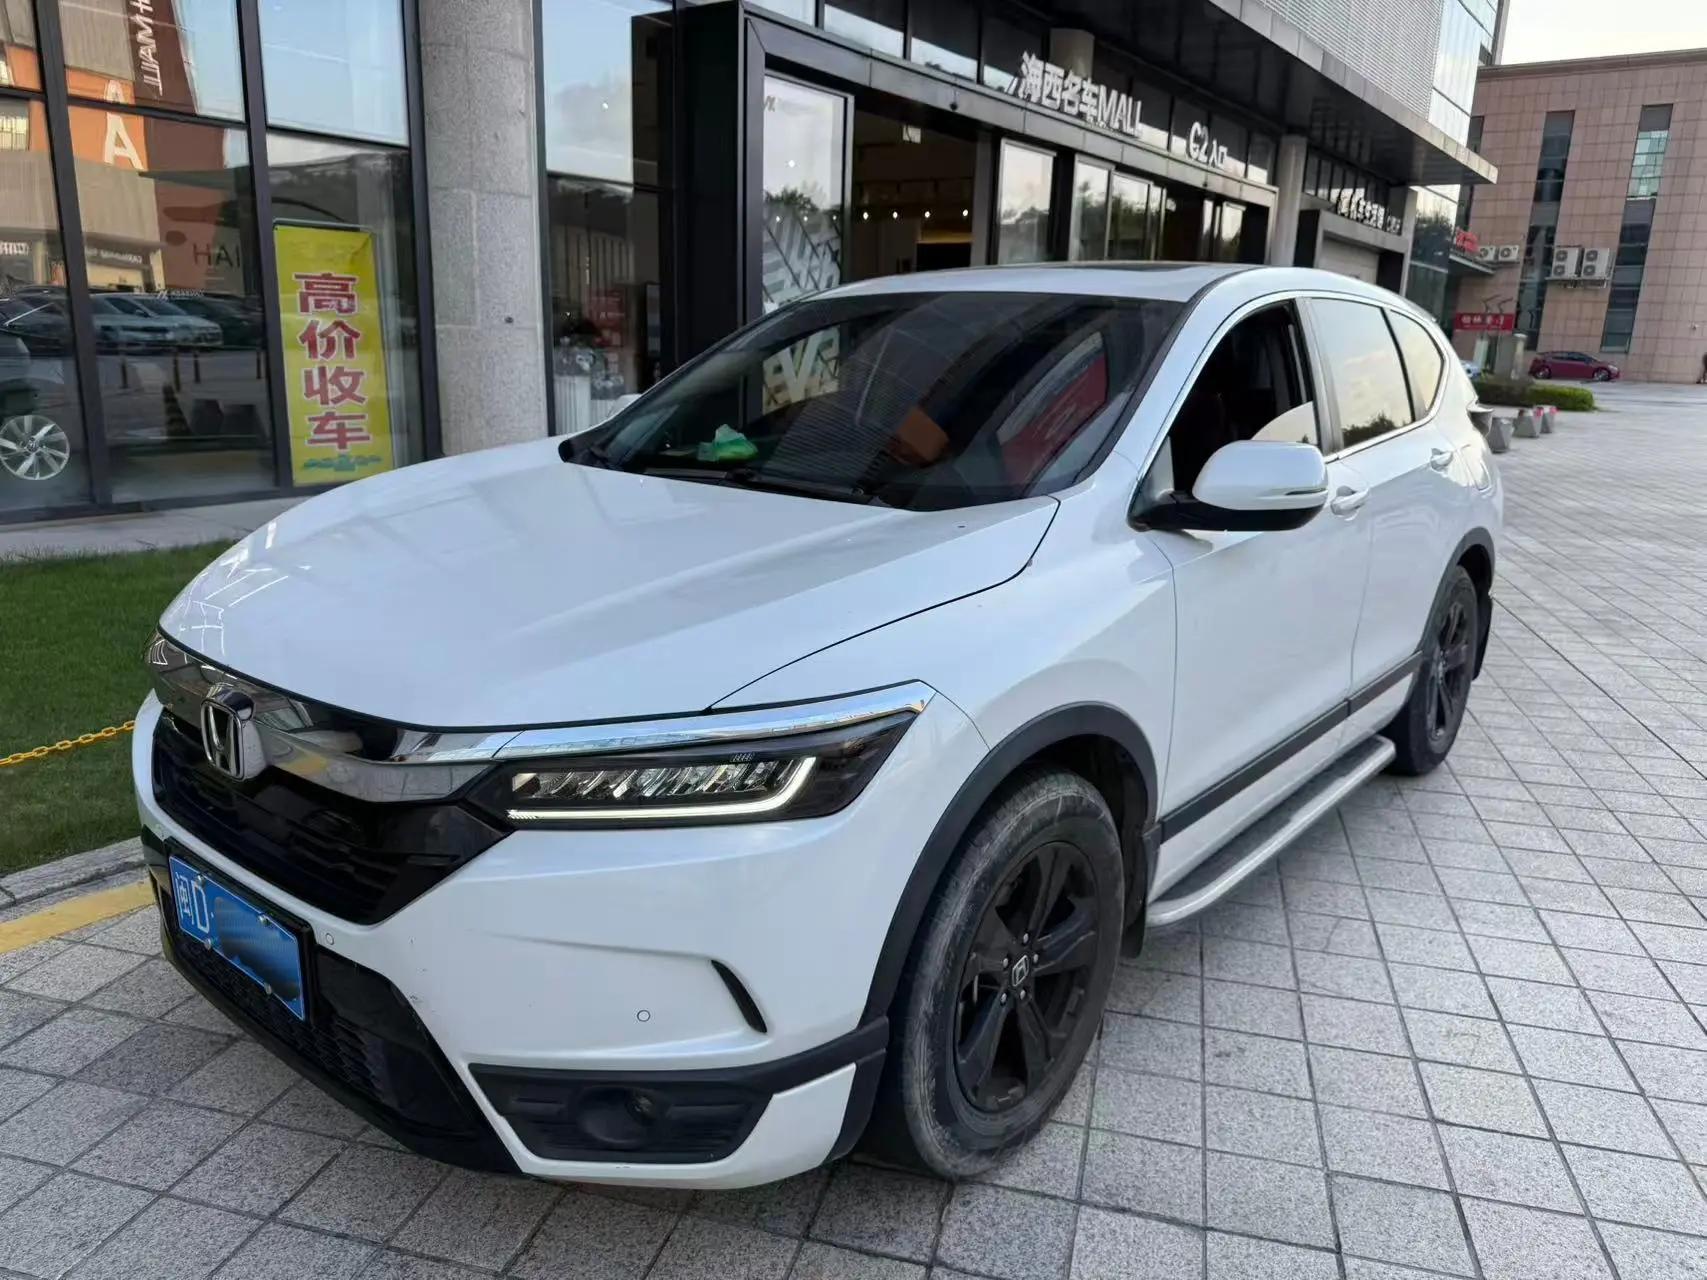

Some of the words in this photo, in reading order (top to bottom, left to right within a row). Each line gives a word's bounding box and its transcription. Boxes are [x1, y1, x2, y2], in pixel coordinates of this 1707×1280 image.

[1018, 51, 1142, 135] 海西名车MALL
[293, 272, 371, 451] 高价收车
